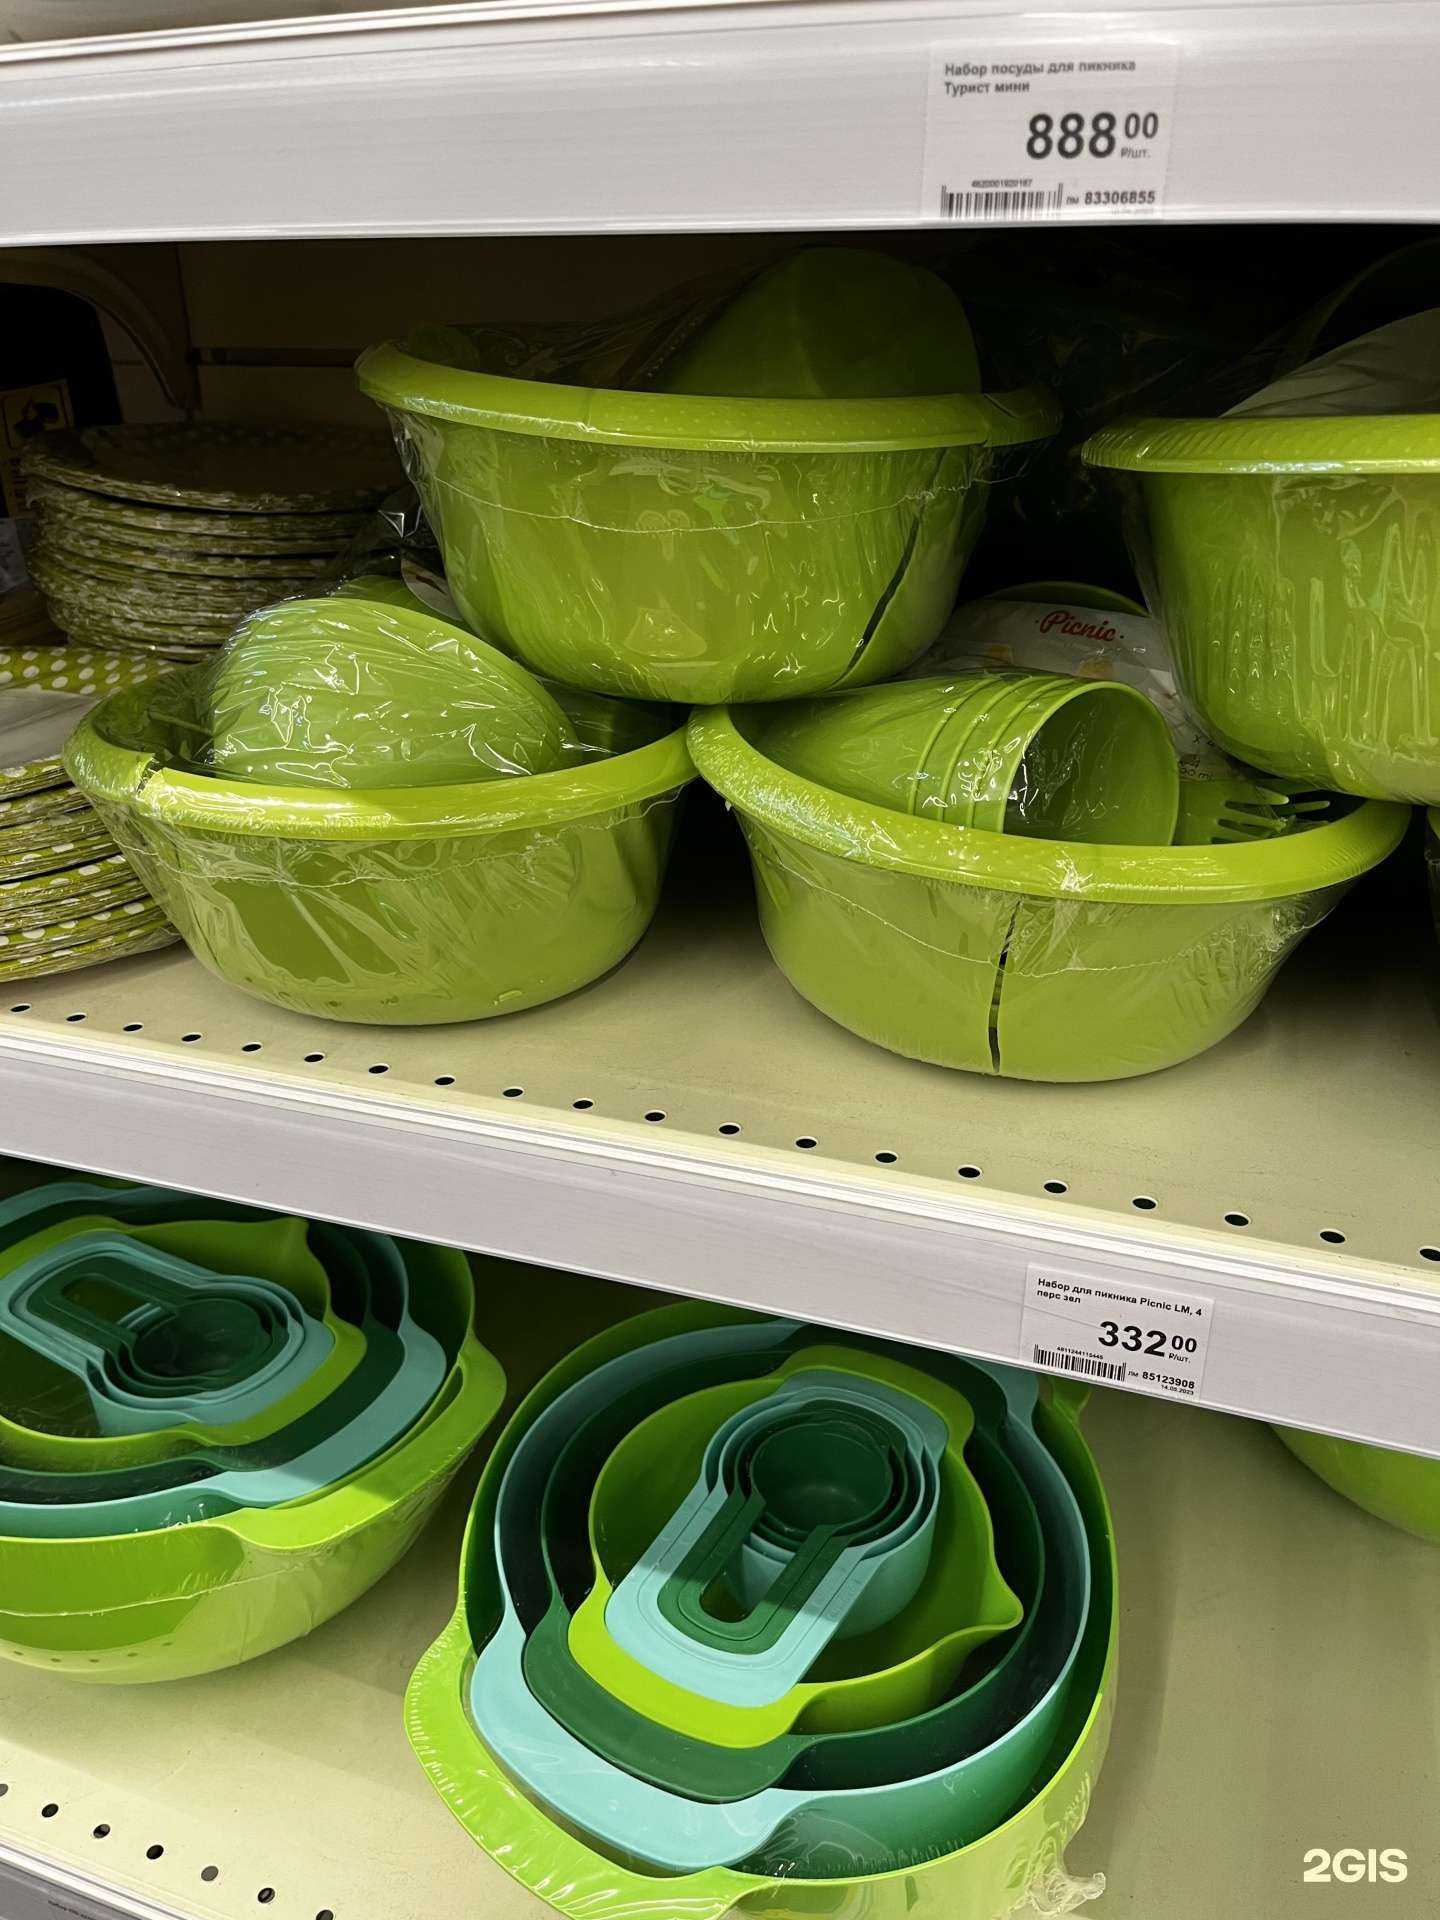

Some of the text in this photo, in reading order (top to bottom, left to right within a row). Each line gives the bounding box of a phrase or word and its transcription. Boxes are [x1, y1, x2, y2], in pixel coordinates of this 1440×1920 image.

[945, 60, 1136, 77] Набор посуды для пикника
[944, 81, 1030, 97] Турист мини
[1026, 112, 1159, 159] 888 00
[1084, 190, 1156, 205] 83306855
[1040, 610, 1117, 642] Picnic
[1036, 1289, 1081, 1304] перс зел
[1038, 1278, 1202, 1317] Набор для пикника Picnic LM, 4
[1098, 1320, 1197, 1357] 332 00
[1142, 1371, 1195, 1389] 85123908
